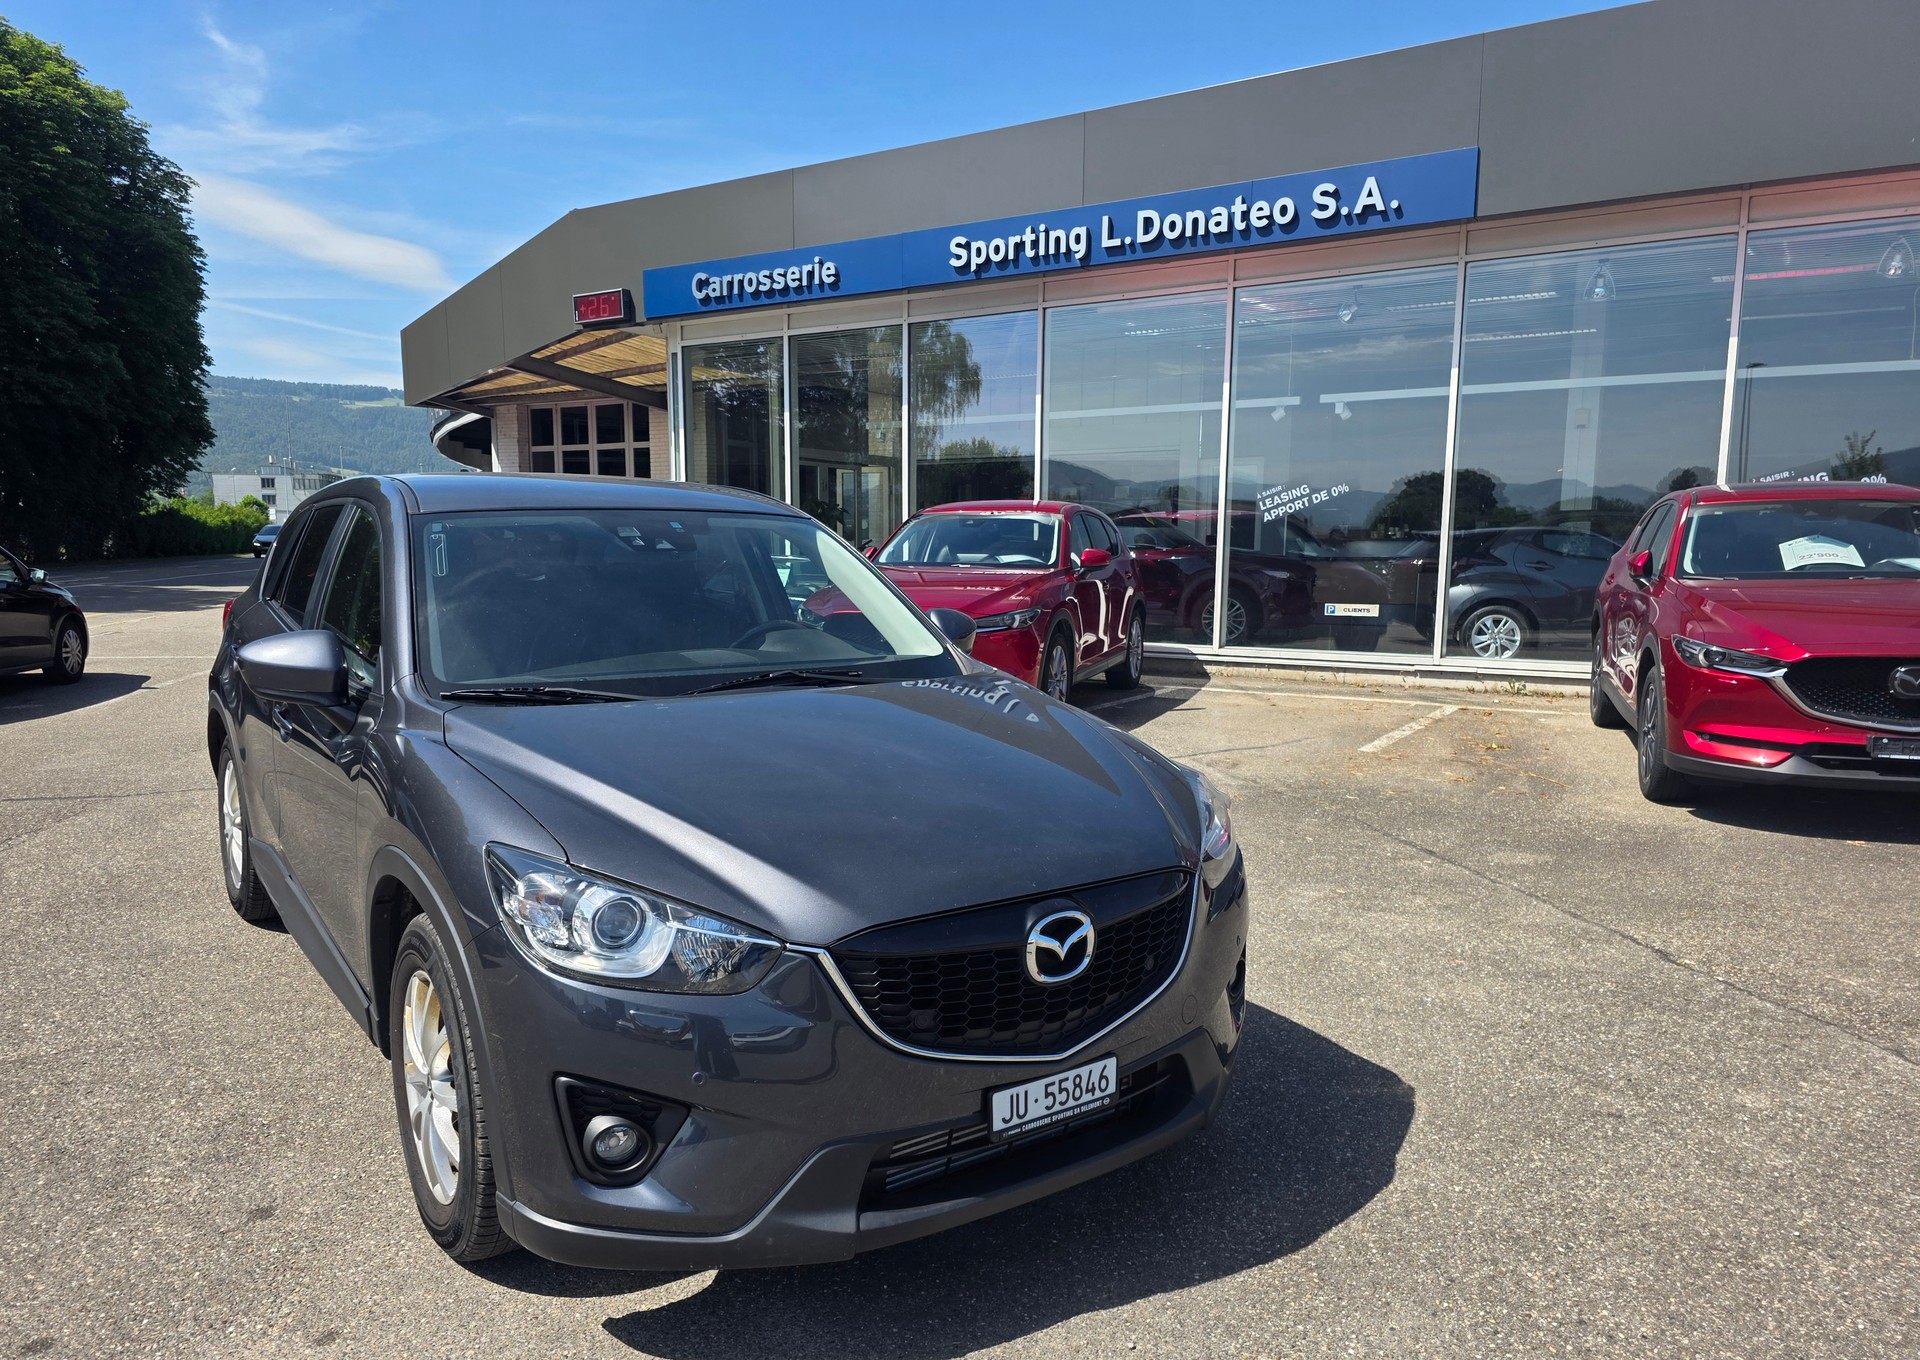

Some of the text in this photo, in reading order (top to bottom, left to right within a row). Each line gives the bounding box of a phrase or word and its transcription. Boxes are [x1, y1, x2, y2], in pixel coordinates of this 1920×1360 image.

[949, 176, 1400, 272] Sporting L.Donateo S.A.
[691, 256, 836, 299] Carrosserie
[1259, 485, 1310, 510] LEASING
[1262, 485, 1282, 497] SAISIR
[1264, 483, 1350, 522] APPORT DE 0%
[1001, 1090, 1029, 1125] JU
[1044, 1064, 1109, 1111] 55846
